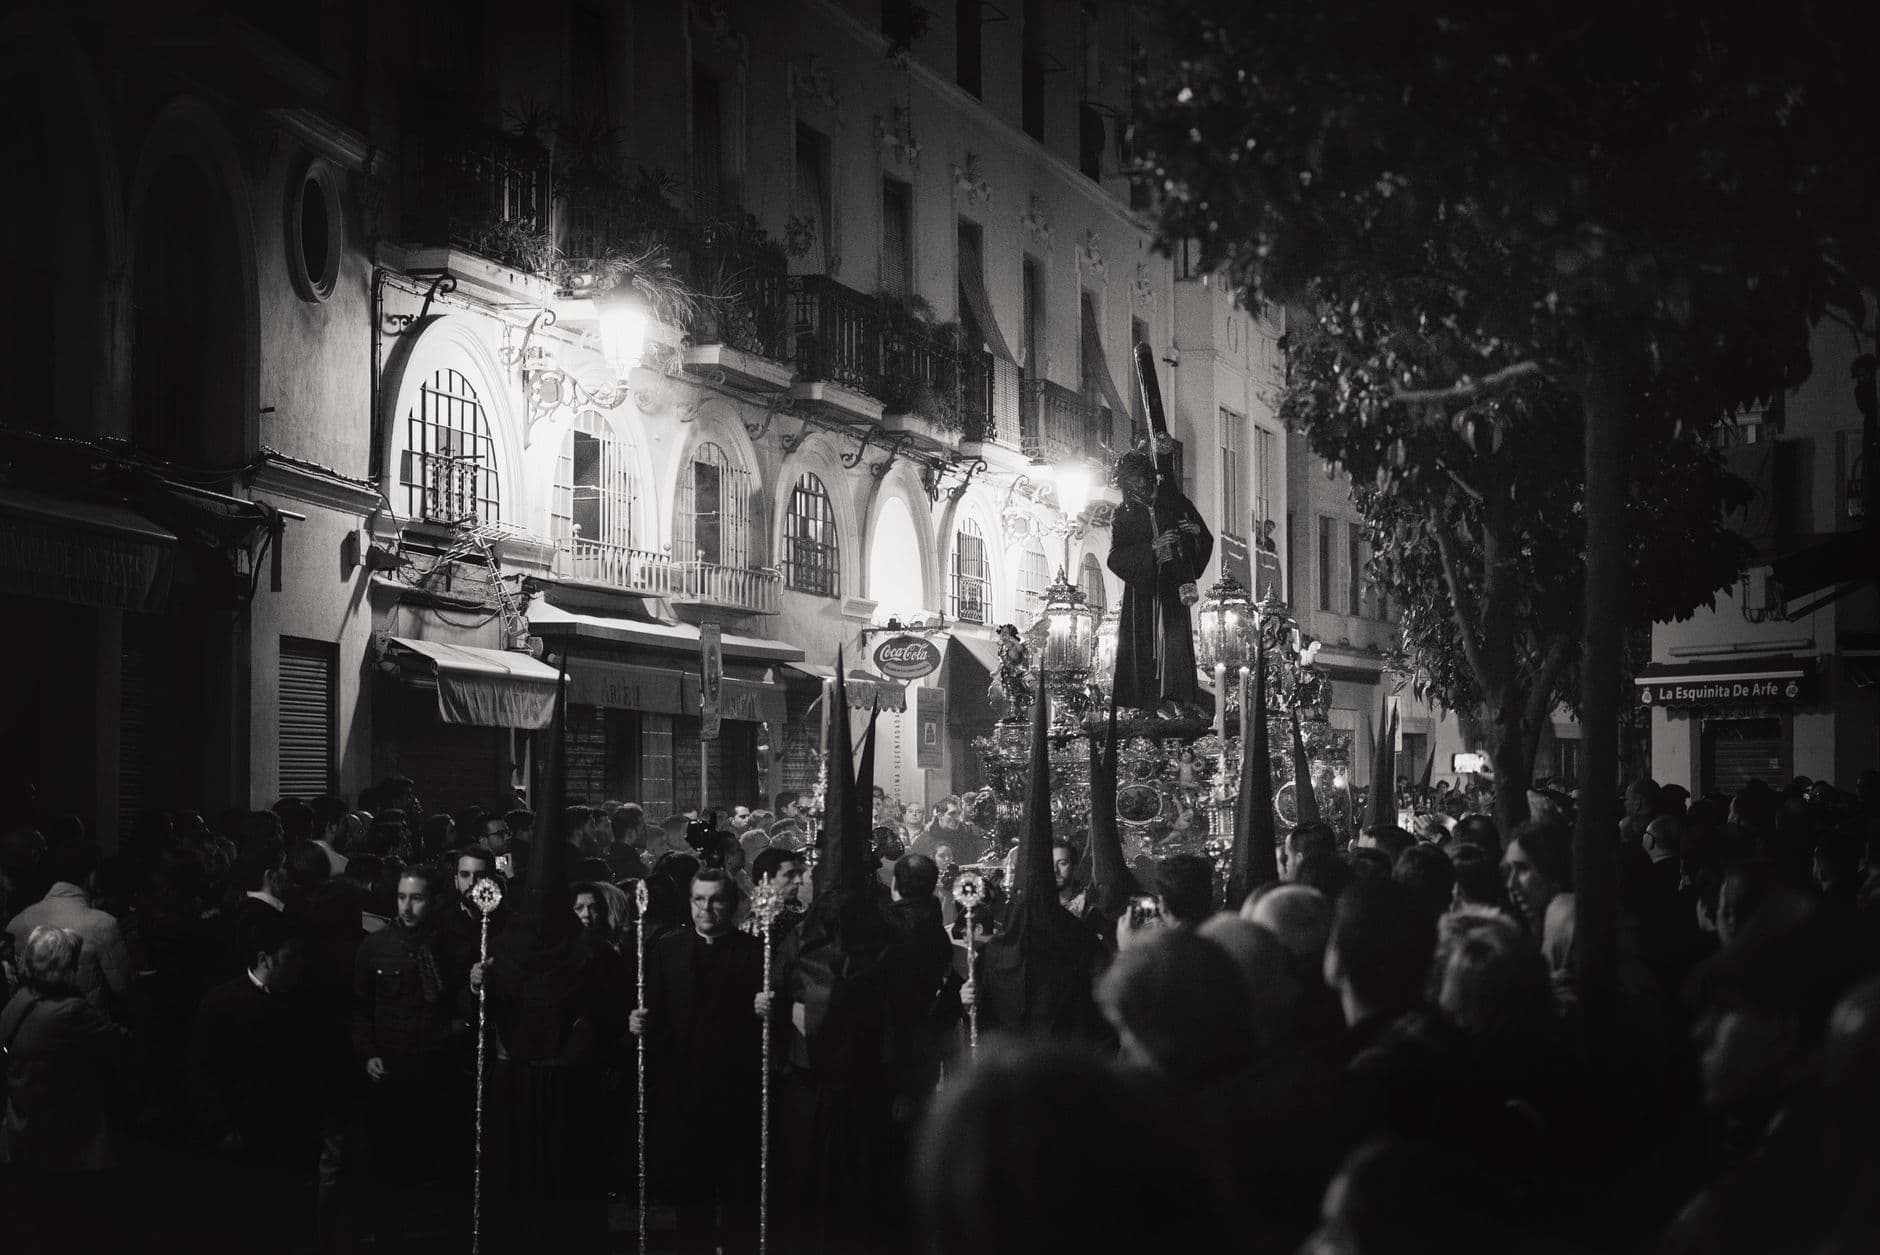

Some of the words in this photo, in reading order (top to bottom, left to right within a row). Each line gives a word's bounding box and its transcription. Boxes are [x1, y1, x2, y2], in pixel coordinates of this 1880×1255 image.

[880, 643, 929, 662] Coca-Cola
[1659, 687, 1673, 700] La
[1676, 685, 1731, 702] Esquinita
[1733, 684, 1750, 697] De
[1752, 682, 1778, 696] Arfe
